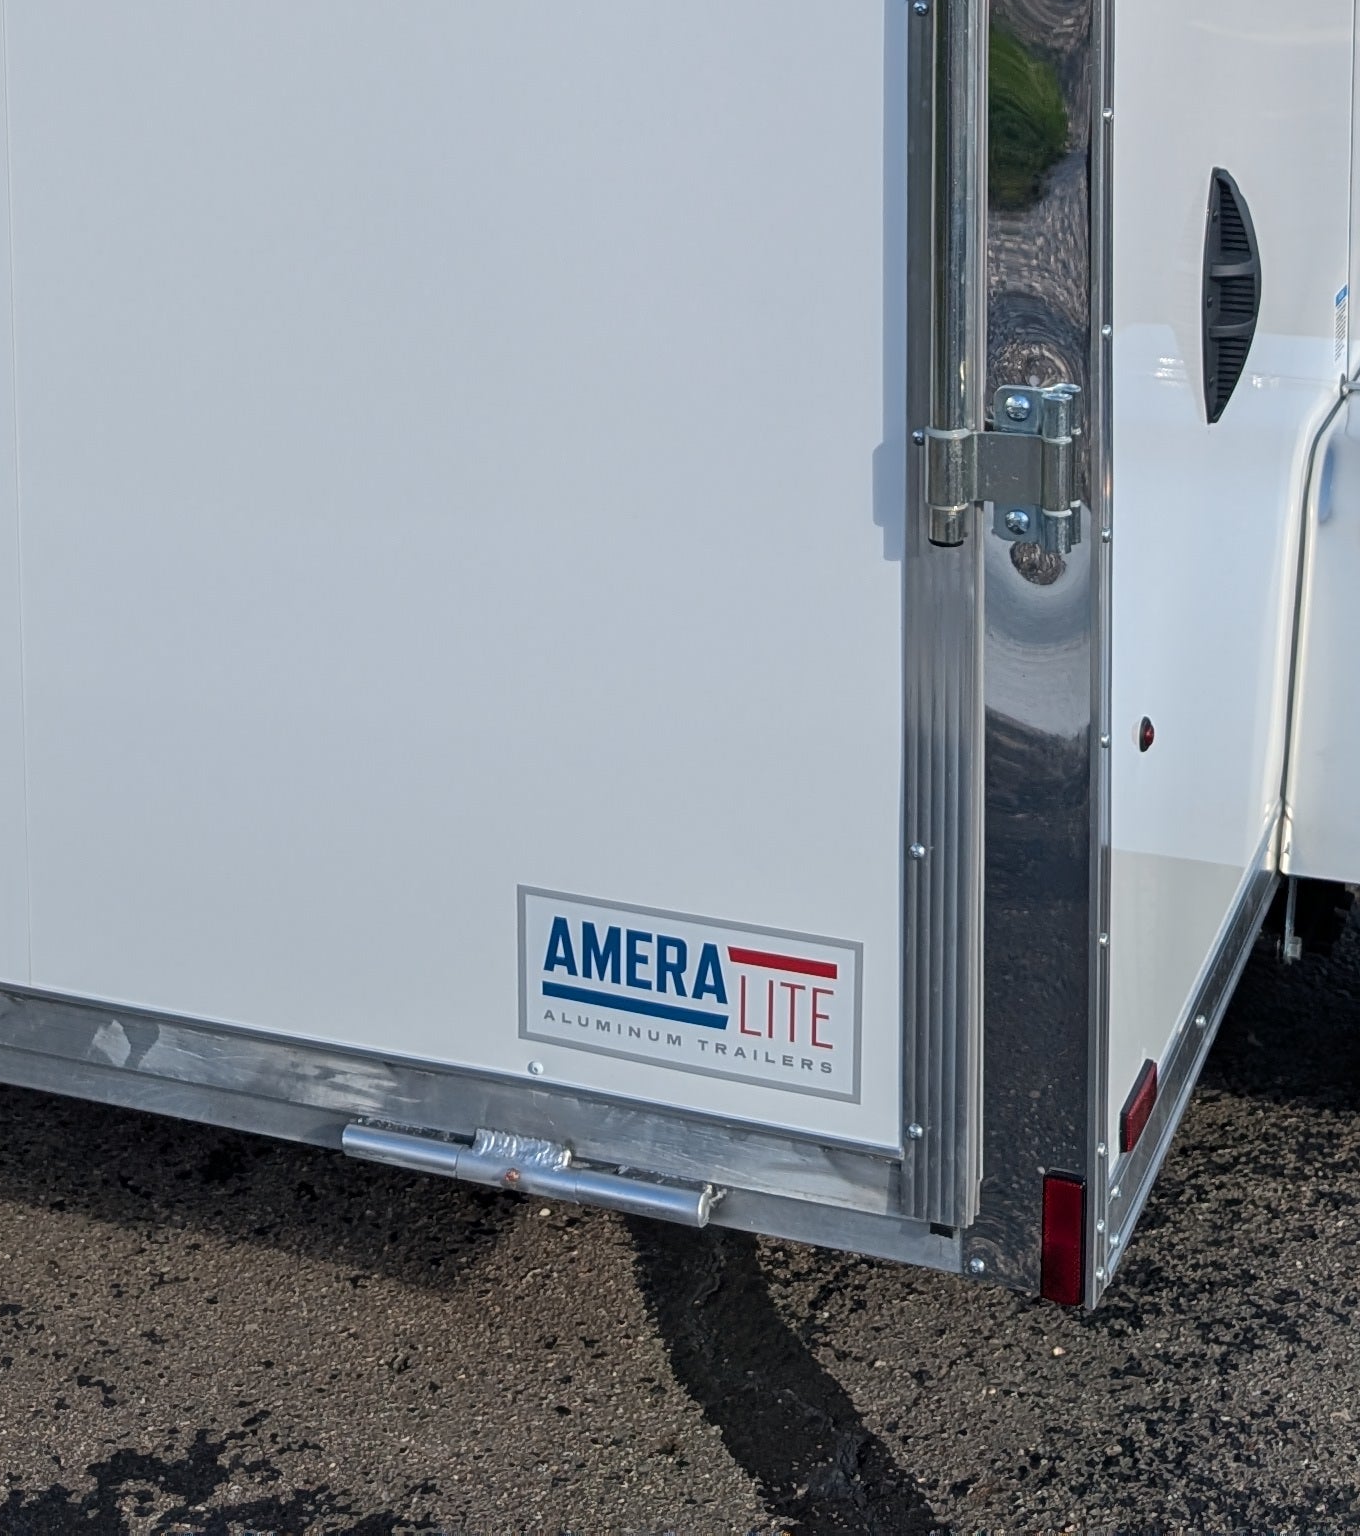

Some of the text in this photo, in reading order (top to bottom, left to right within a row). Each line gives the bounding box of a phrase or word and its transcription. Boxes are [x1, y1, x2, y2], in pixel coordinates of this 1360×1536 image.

[543, 915, 834, 1050] AMERA LITE
[543, 1008, 834, 1074] ALUMINUM TRAILERS
